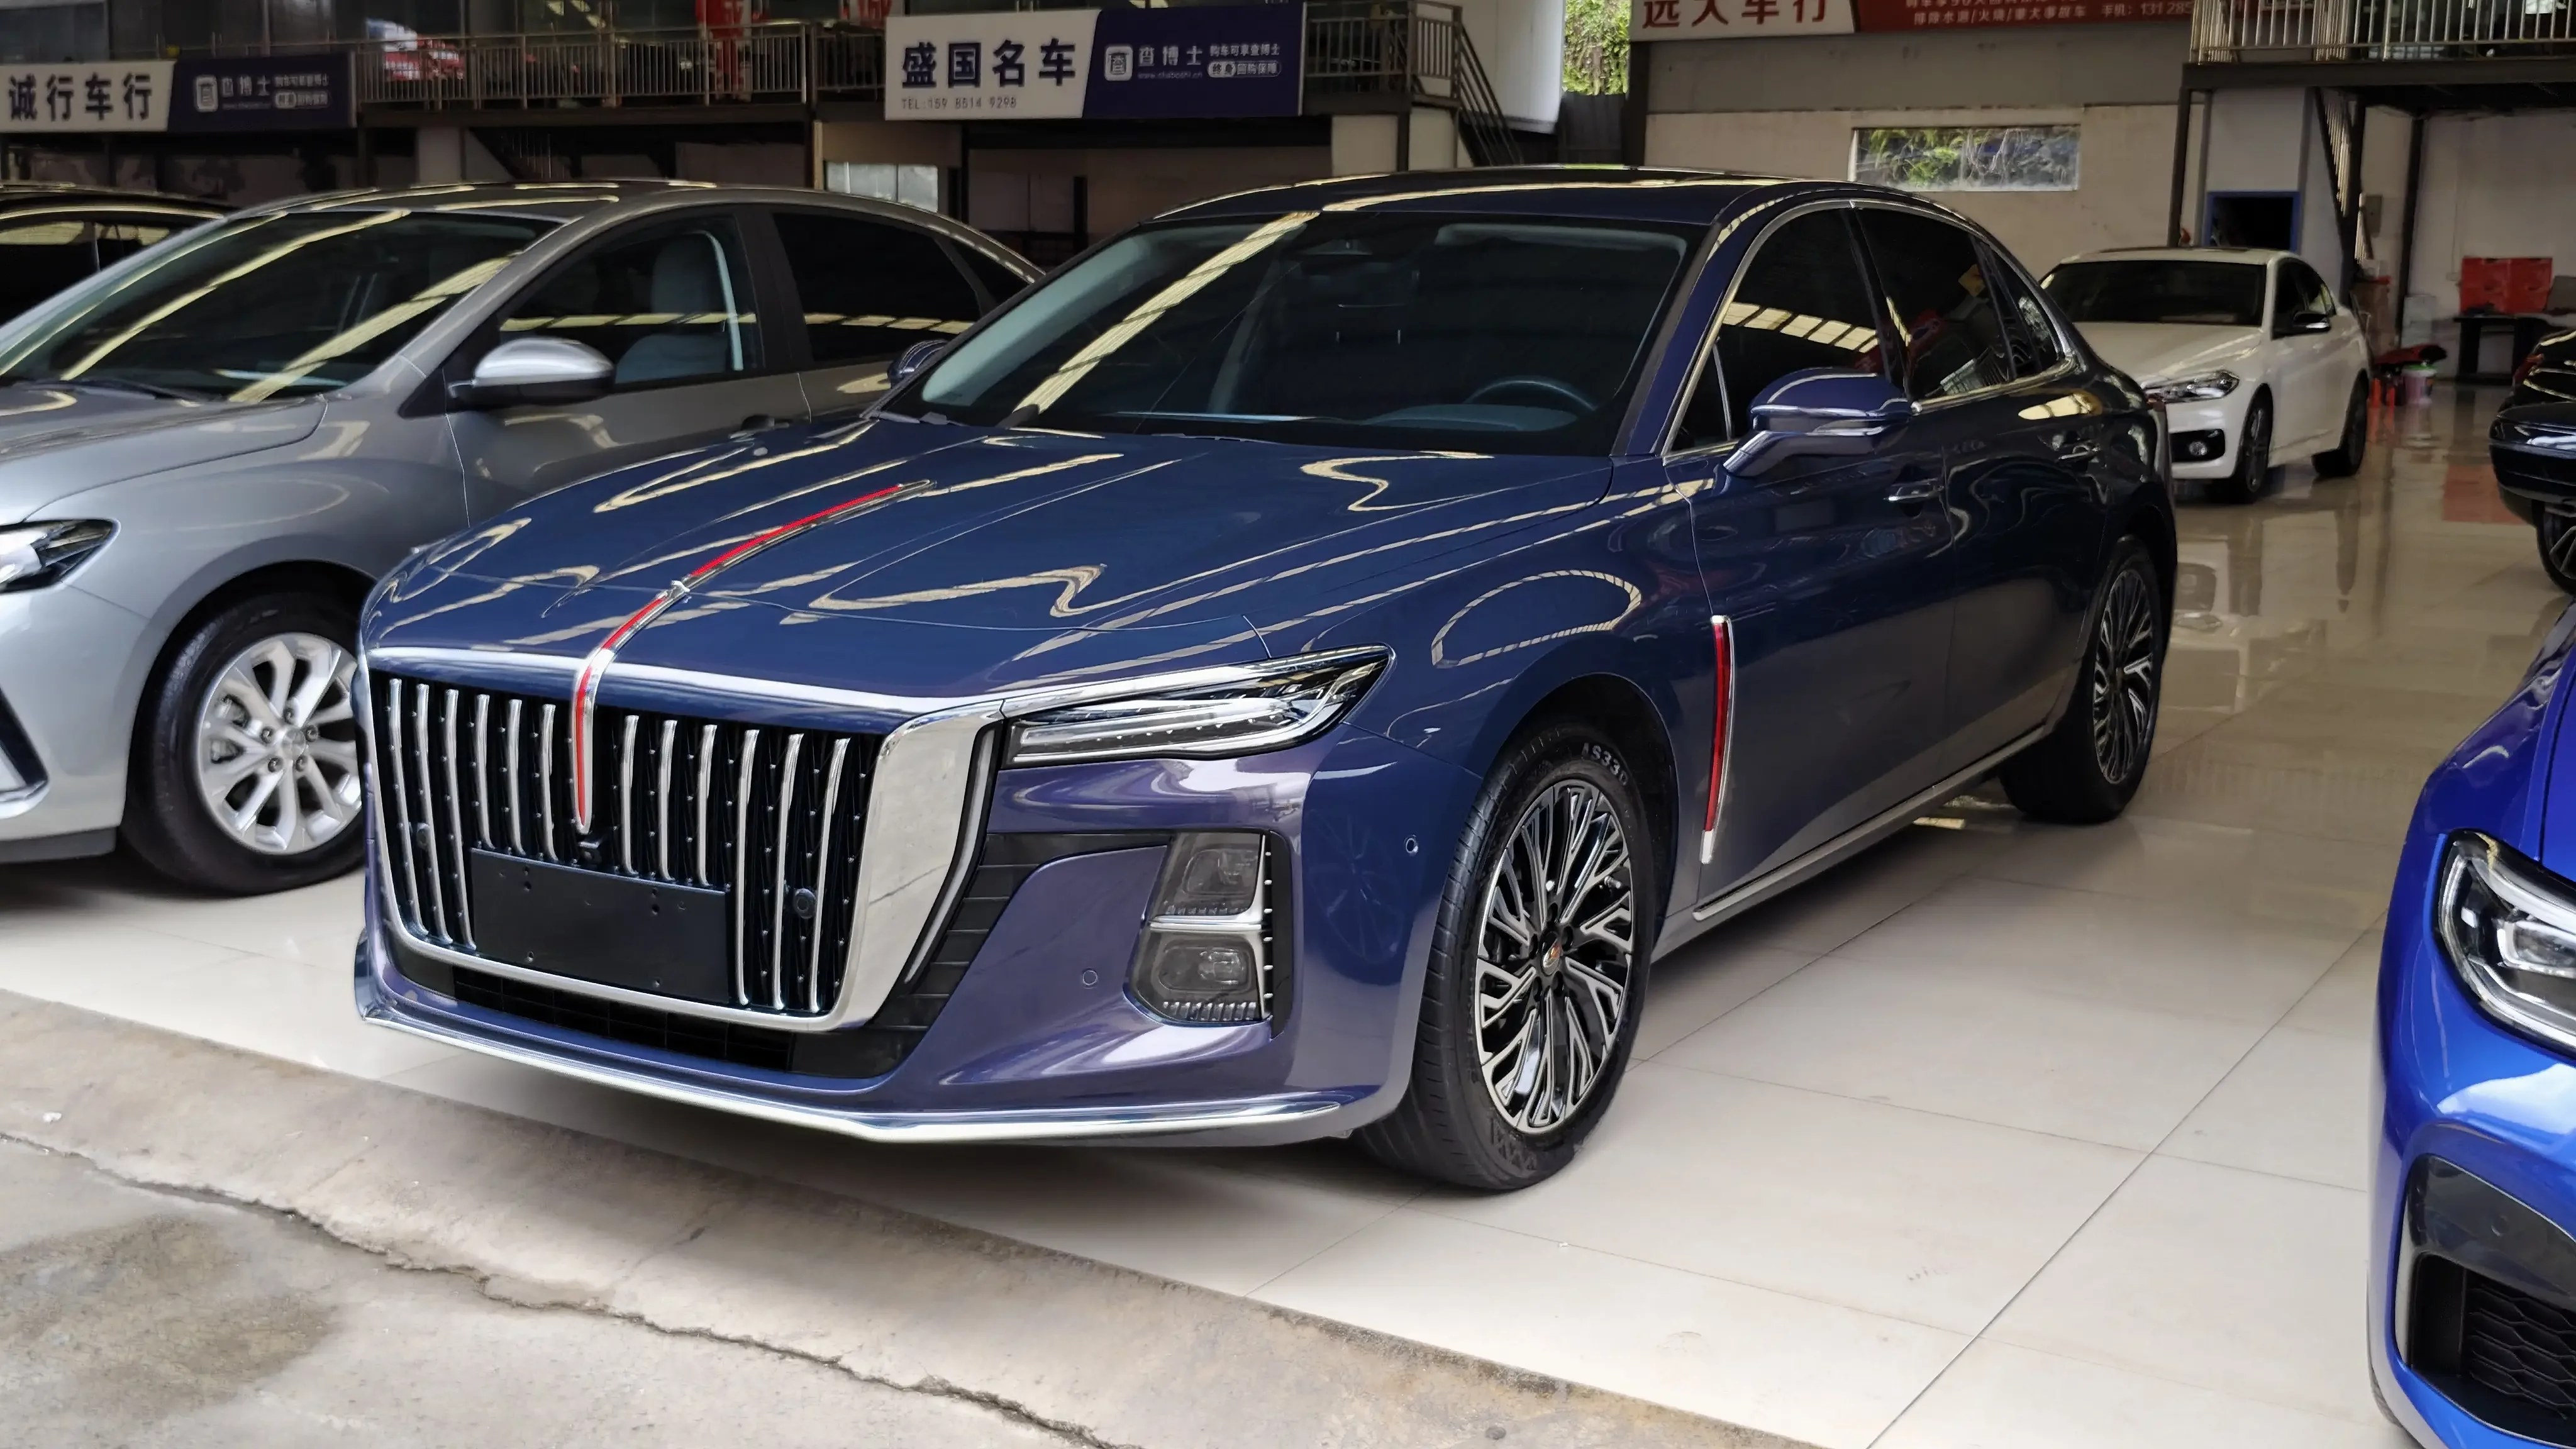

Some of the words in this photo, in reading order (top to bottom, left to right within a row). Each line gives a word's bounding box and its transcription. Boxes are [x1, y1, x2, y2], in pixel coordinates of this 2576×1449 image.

[901, 38, 1076, 89] 盛国名车
[1138, 45, 1203, 67] 查博士
[9, 72, 152, 121] 诚行车行
